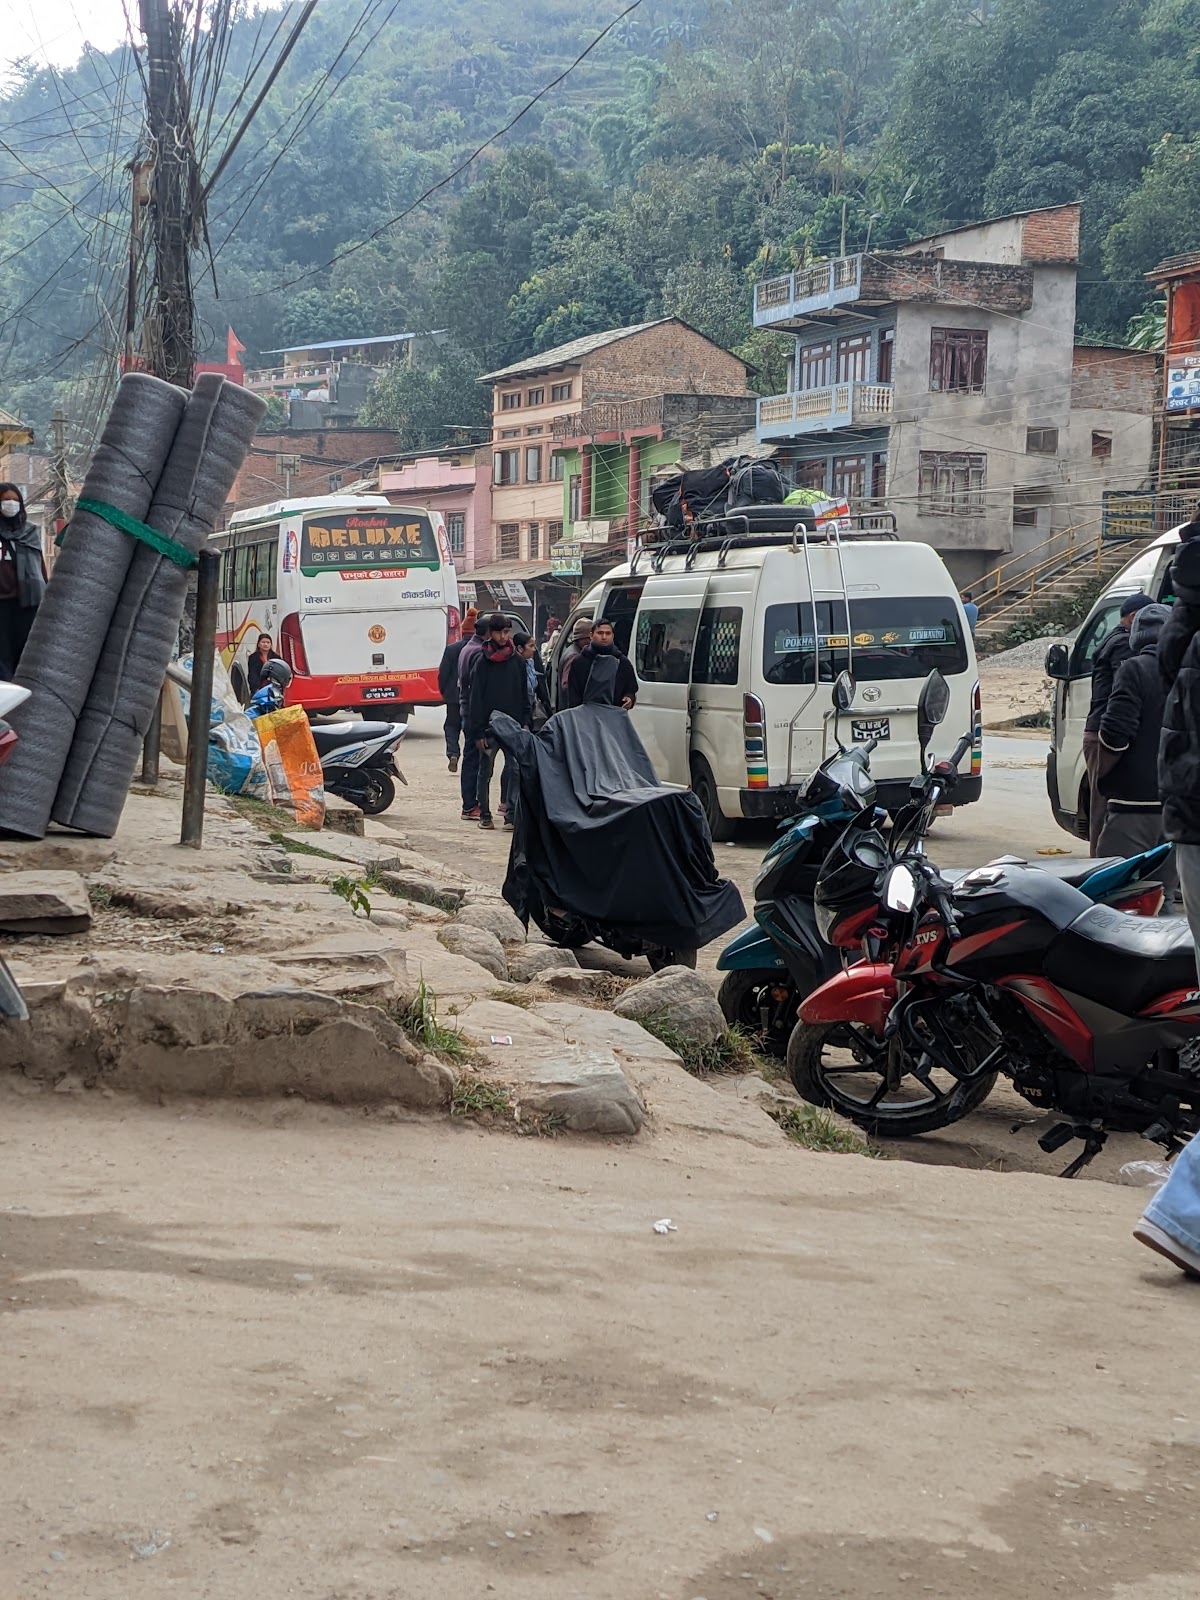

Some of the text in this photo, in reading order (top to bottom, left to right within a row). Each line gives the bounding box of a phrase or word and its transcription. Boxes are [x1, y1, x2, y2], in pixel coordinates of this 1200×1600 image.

[308, 522, 422, 548] DELUXE
[304, 595, 332, 604] पोखरा
[784, 637, 825, 648] POKHAA
[914, 929, 939, 945] TVS
[1022, 1086, 1043, 1097] TVS
